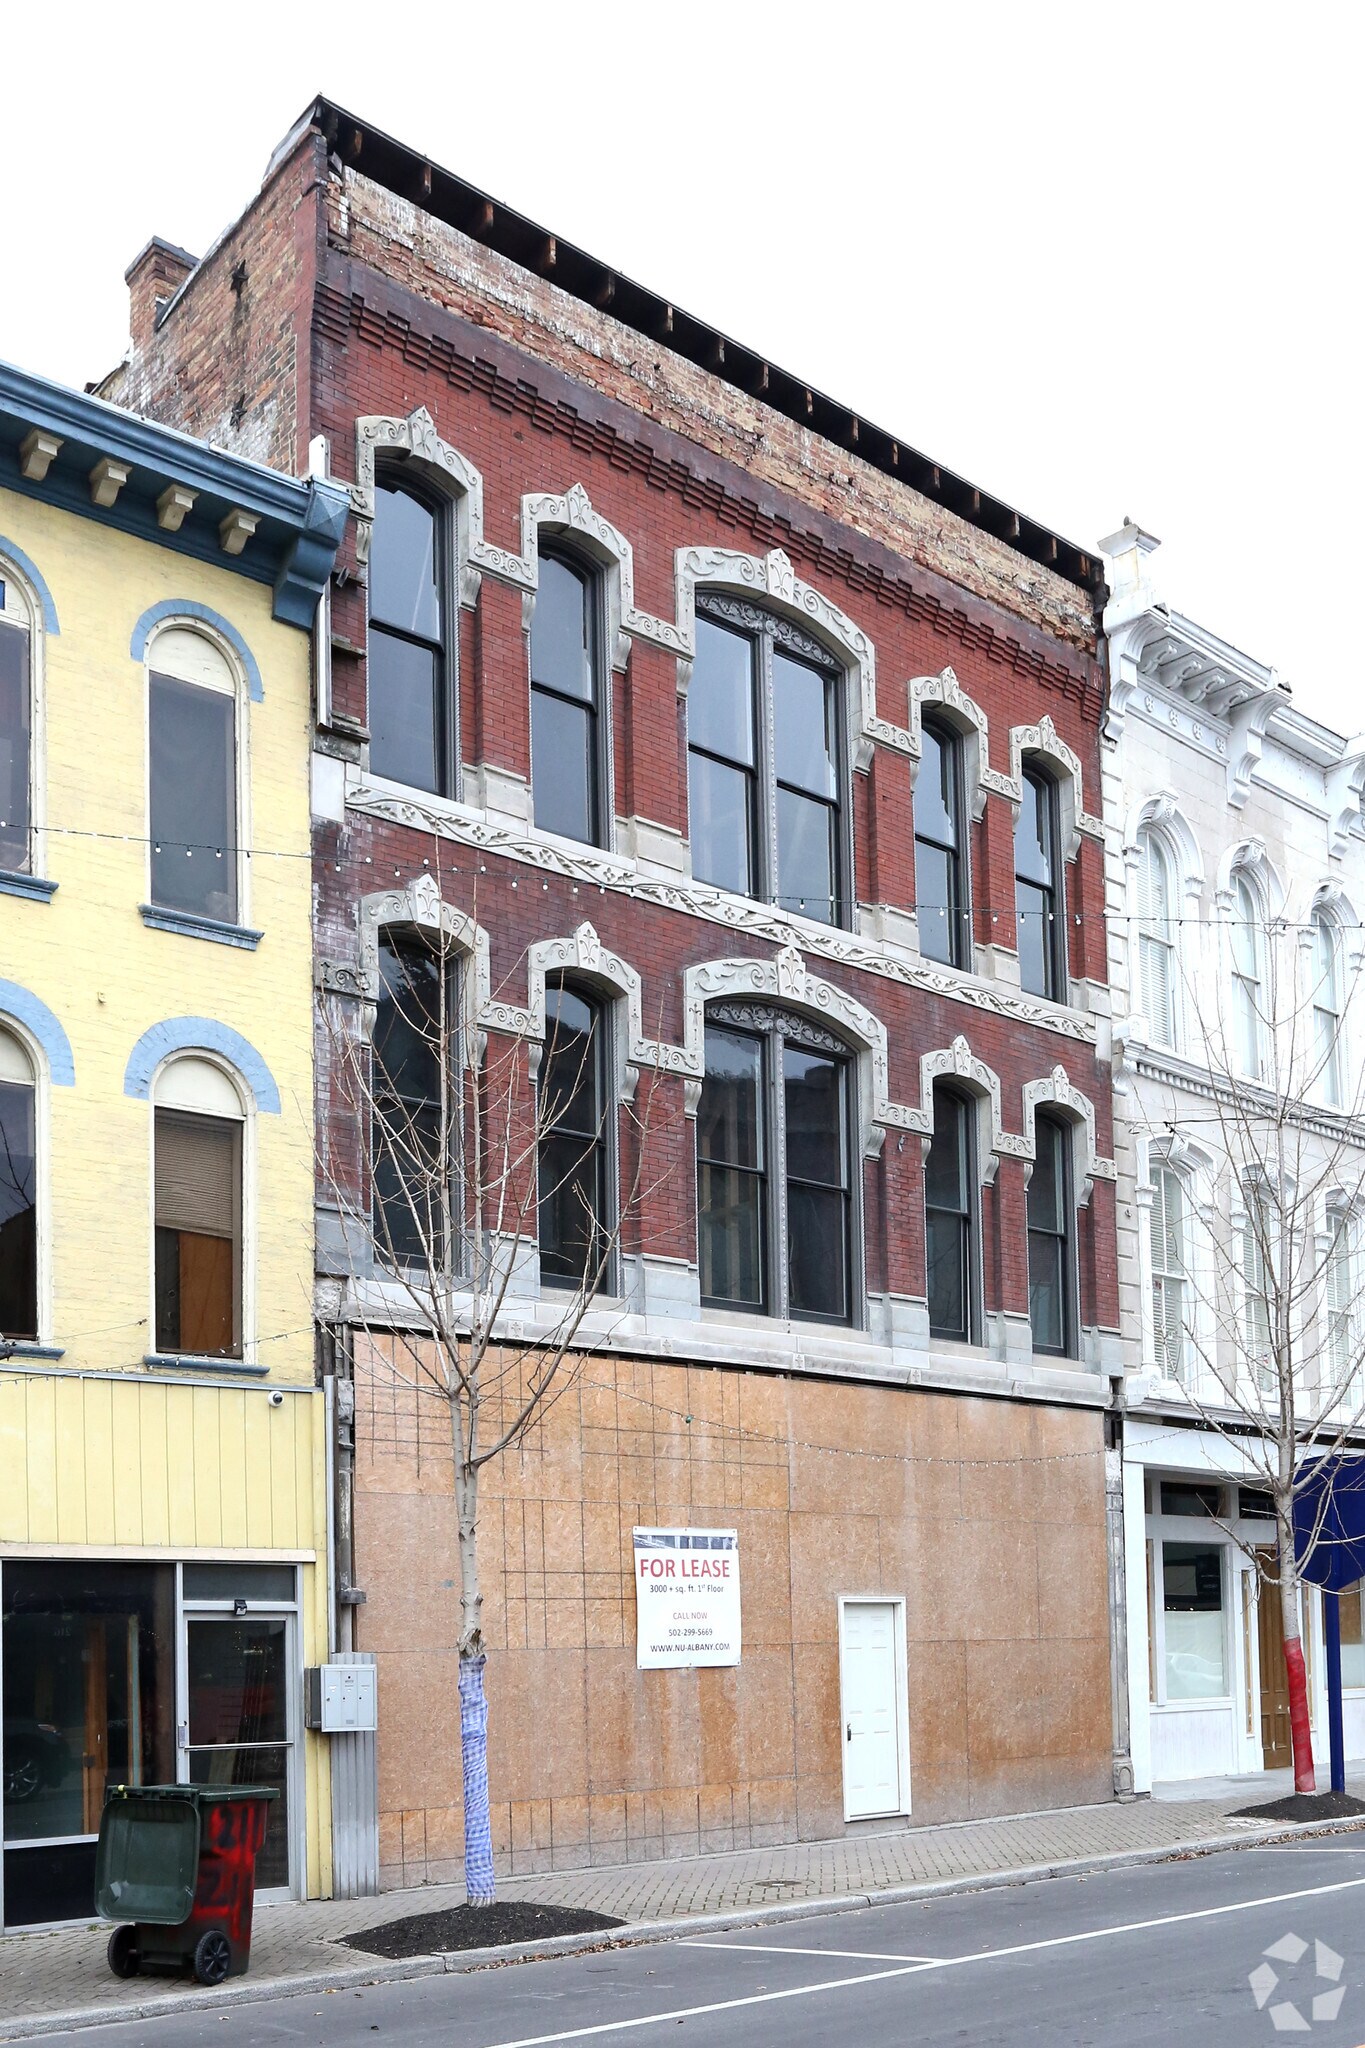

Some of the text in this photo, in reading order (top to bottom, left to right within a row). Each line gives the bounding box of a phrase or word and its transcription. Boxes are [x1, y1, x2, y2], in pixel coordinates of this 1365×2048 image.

[640, 1558, 730, 1578] FOR LEASE
[649, 1584, 668, 1593] 3000
[675, 1586, 686, 1594] sq.
[687, 1583, 697, 1593] ft.
[707, 1584, 724, 1593] Floor
[672, 1612, 708, 1620] CALL NOW
[668, 1628, 713, 1637] 502-299-5669
[650, 1643, 731, 1653] WWW.NU-ALBANY.COM
